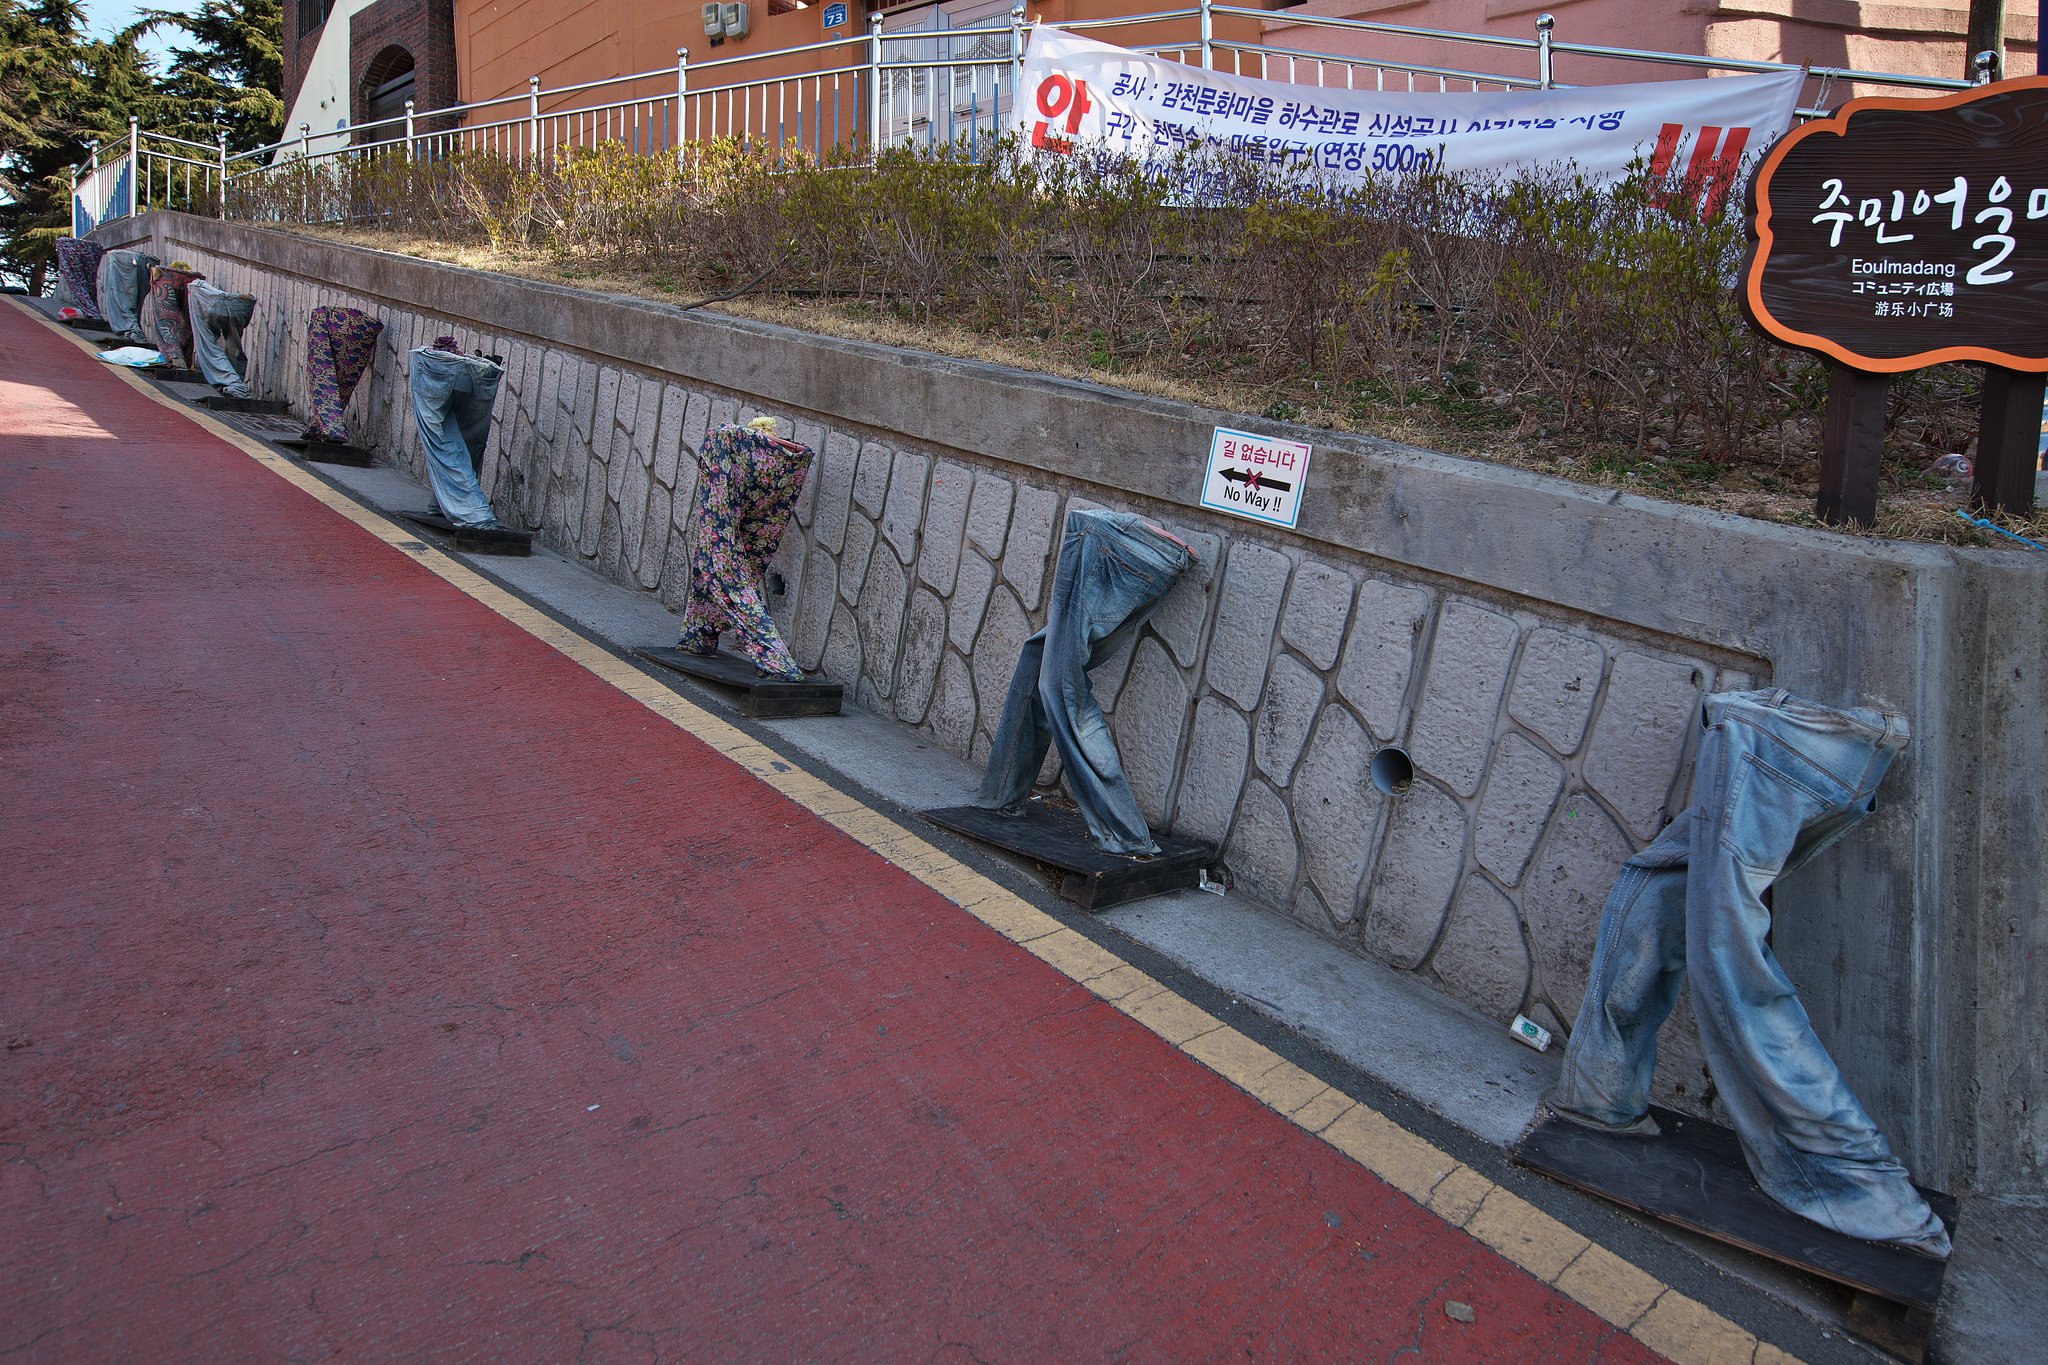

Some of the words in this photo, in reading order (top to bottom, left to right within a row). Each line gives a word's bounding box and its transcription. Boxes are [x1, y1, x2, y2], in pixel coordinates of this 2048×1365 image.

[827, 13, 842, 25] 73
[1032, 73, 1092, 156] 안
[1111, 72, 1147, 100] 공사
[1161, 82, 1274, 125] 감천문화마을
[1278, 102, 1360, 136] 하수관로
[1106, 111, 1137, 140] 구간
[1314, 141, 1367, 171] (연장
[1371, 142, 1444, 173] 500m)
[1648, 122, 1752, 225] 내
[1851, 258, 1956, 278] Eoulmadang
[1852, 281, 1954, 297] コミュニティ広場
[1874, 301, 1953, 318] 游乐小广场
[1223, 440, 1237, 459] 길
[1241, 443, 1296, 471] 없습니다
[1223, 485, 1241, 502] No
[1245, 489, 1270, 512] Way
